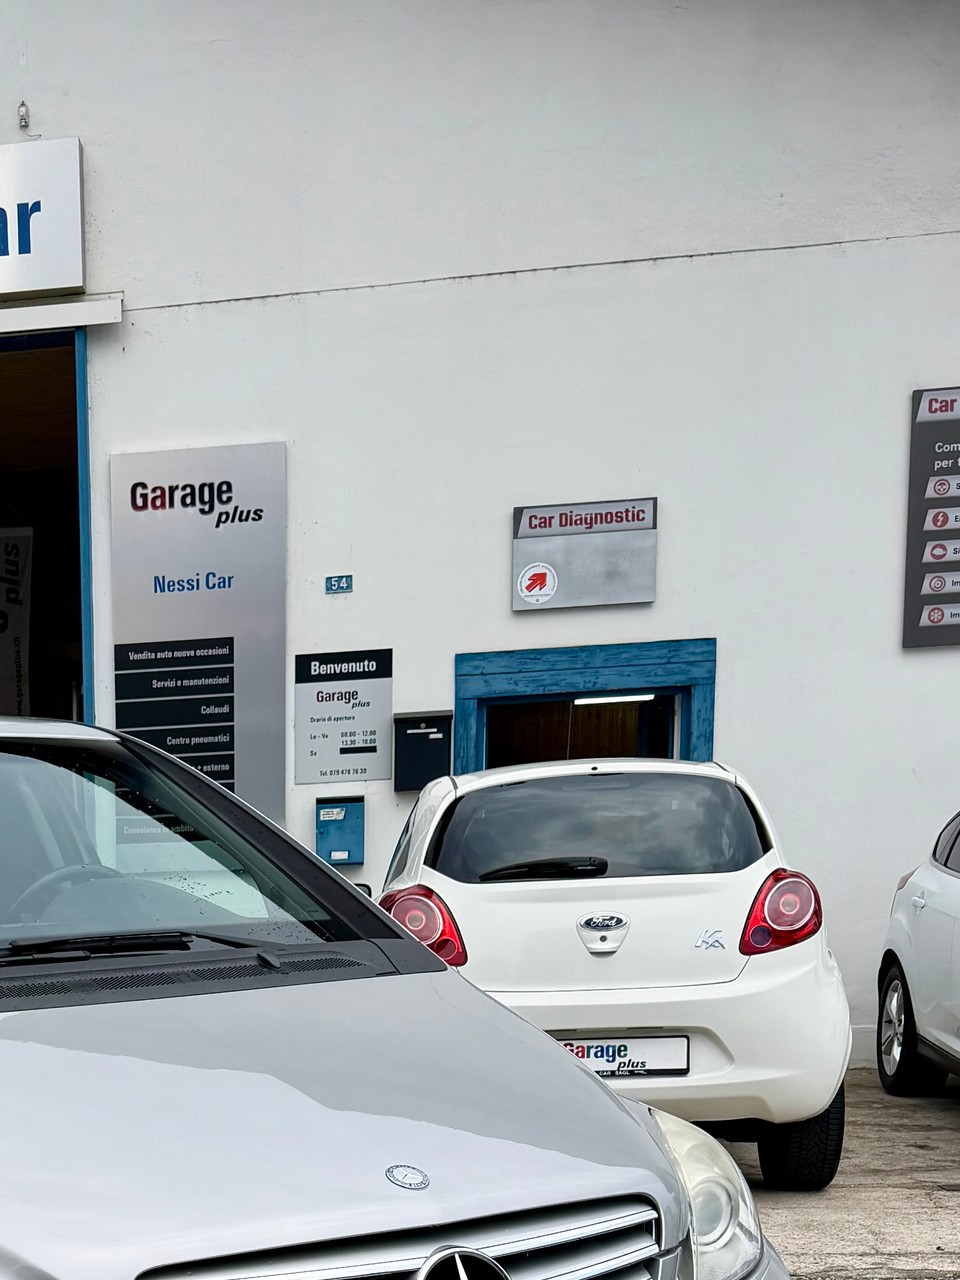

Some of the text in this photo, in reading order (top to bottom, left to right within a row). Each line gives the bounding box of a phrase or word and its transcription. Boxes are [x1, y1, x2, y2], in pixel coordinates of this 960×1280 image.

[928, 397, 958, 414] Car
[934, 459, 954, 472] per
[130, 480, 233, 516] Garage
[215, 505, 264, 529] plus
[528, 506, 646, 530] Car Diagnostic
[0, 542, 24, 606] plus
[153, 571, 234, 593] Nessi Car
[331, 576, 349, 590] 54
[128, 651, 156, 661] Vendita
[156, 650, 173, 659] auto
[196, 646, 229, 656] occasioni
[310, 659, 377, 676] Benvenuto
[152, 679, 176, 689] Servizi
[182, 675, 229, 687] manutenzioni
[316, 690, 359, 704] Garage
[201, 704, 229, 715] Collaudi
[351, 700, 371, 709] plus
[166, 733, 230, 746] Centro pneumatici
[203, 764, 230, 772] esterno
[590, 915, 617, 929] Ford
[617, 1059, 647, 1072] plus
